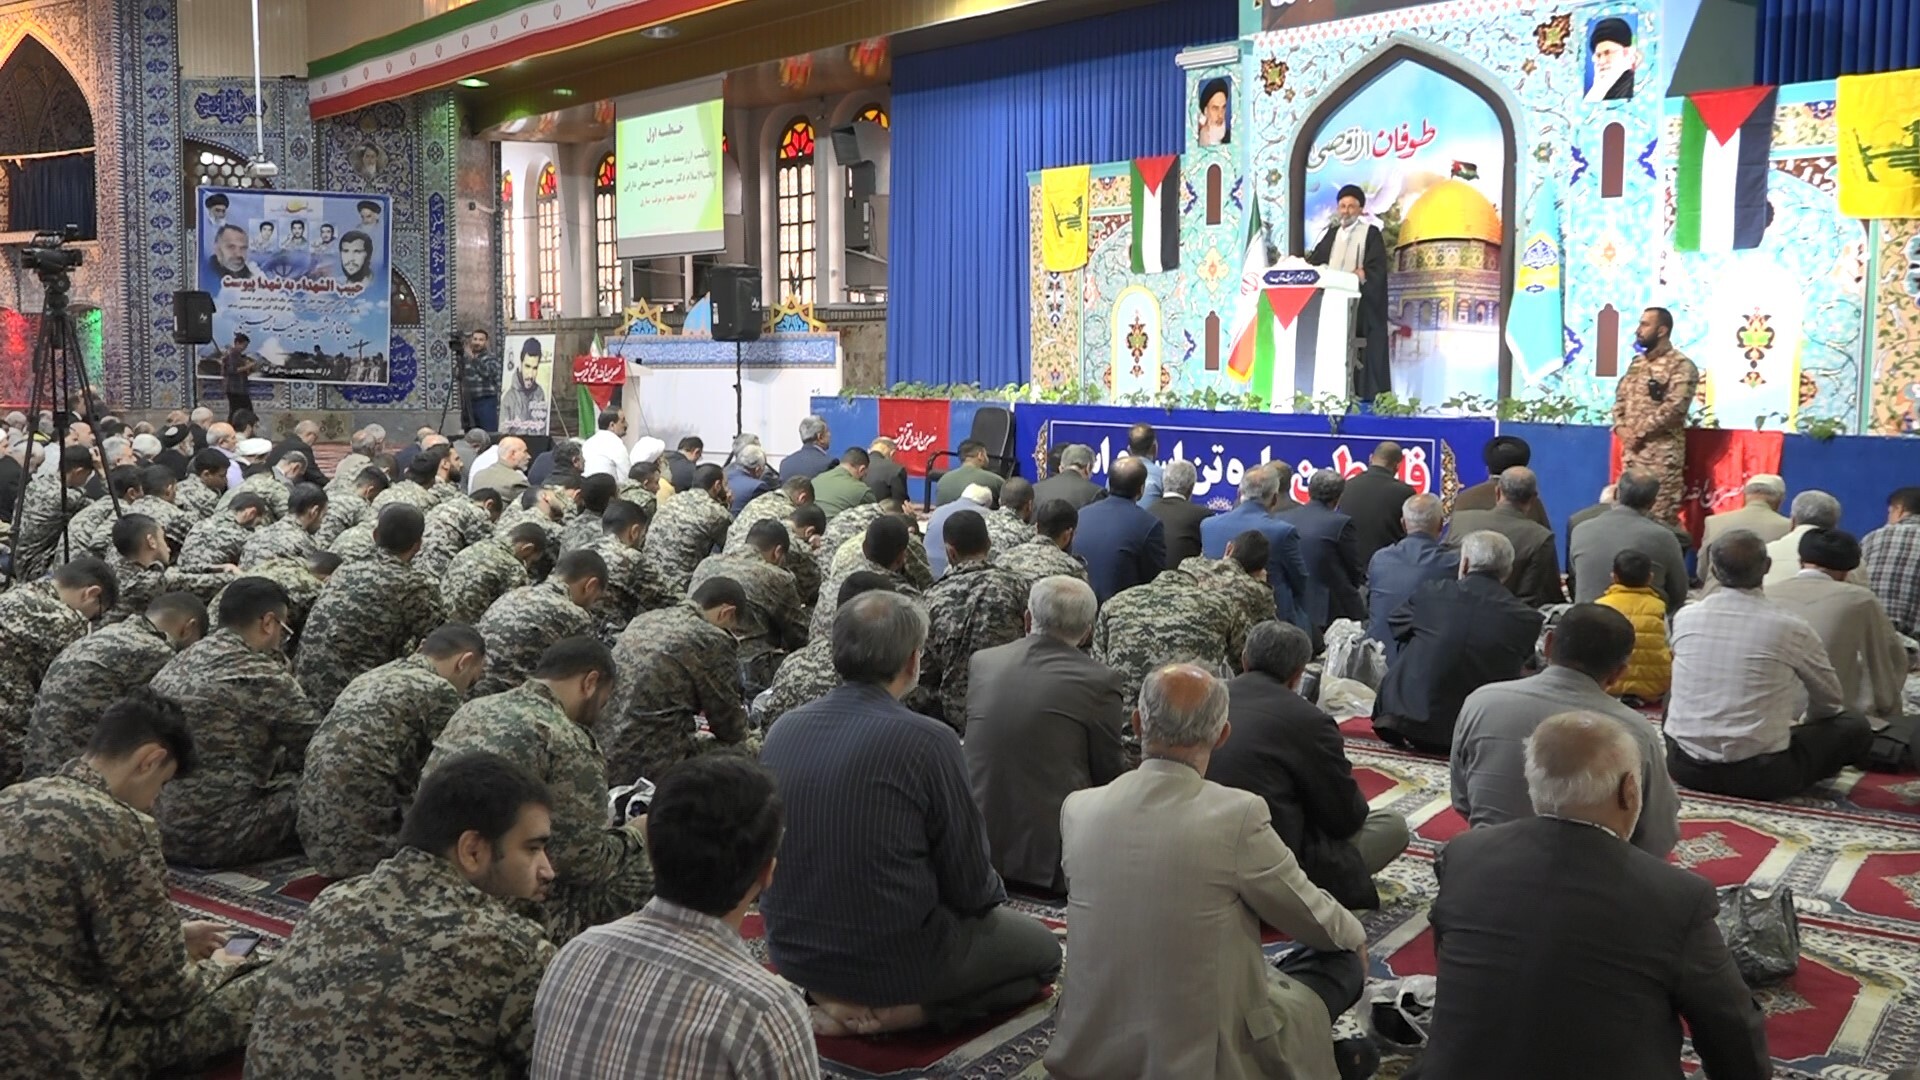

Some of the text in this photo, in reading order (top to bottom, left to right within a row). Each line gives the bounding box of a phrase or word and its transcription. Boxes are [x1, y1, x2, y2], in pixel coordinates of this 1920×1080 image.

[646, 121, 684, 143] خطبه اول
[1371, 118, 1437, 159] طوفان
[222, 277, 256, 292] پیوست
[258, 277, 281, 292] شهدا
[284, 279, 295, 293] به
[337, 284, 364, 296] حبیب
